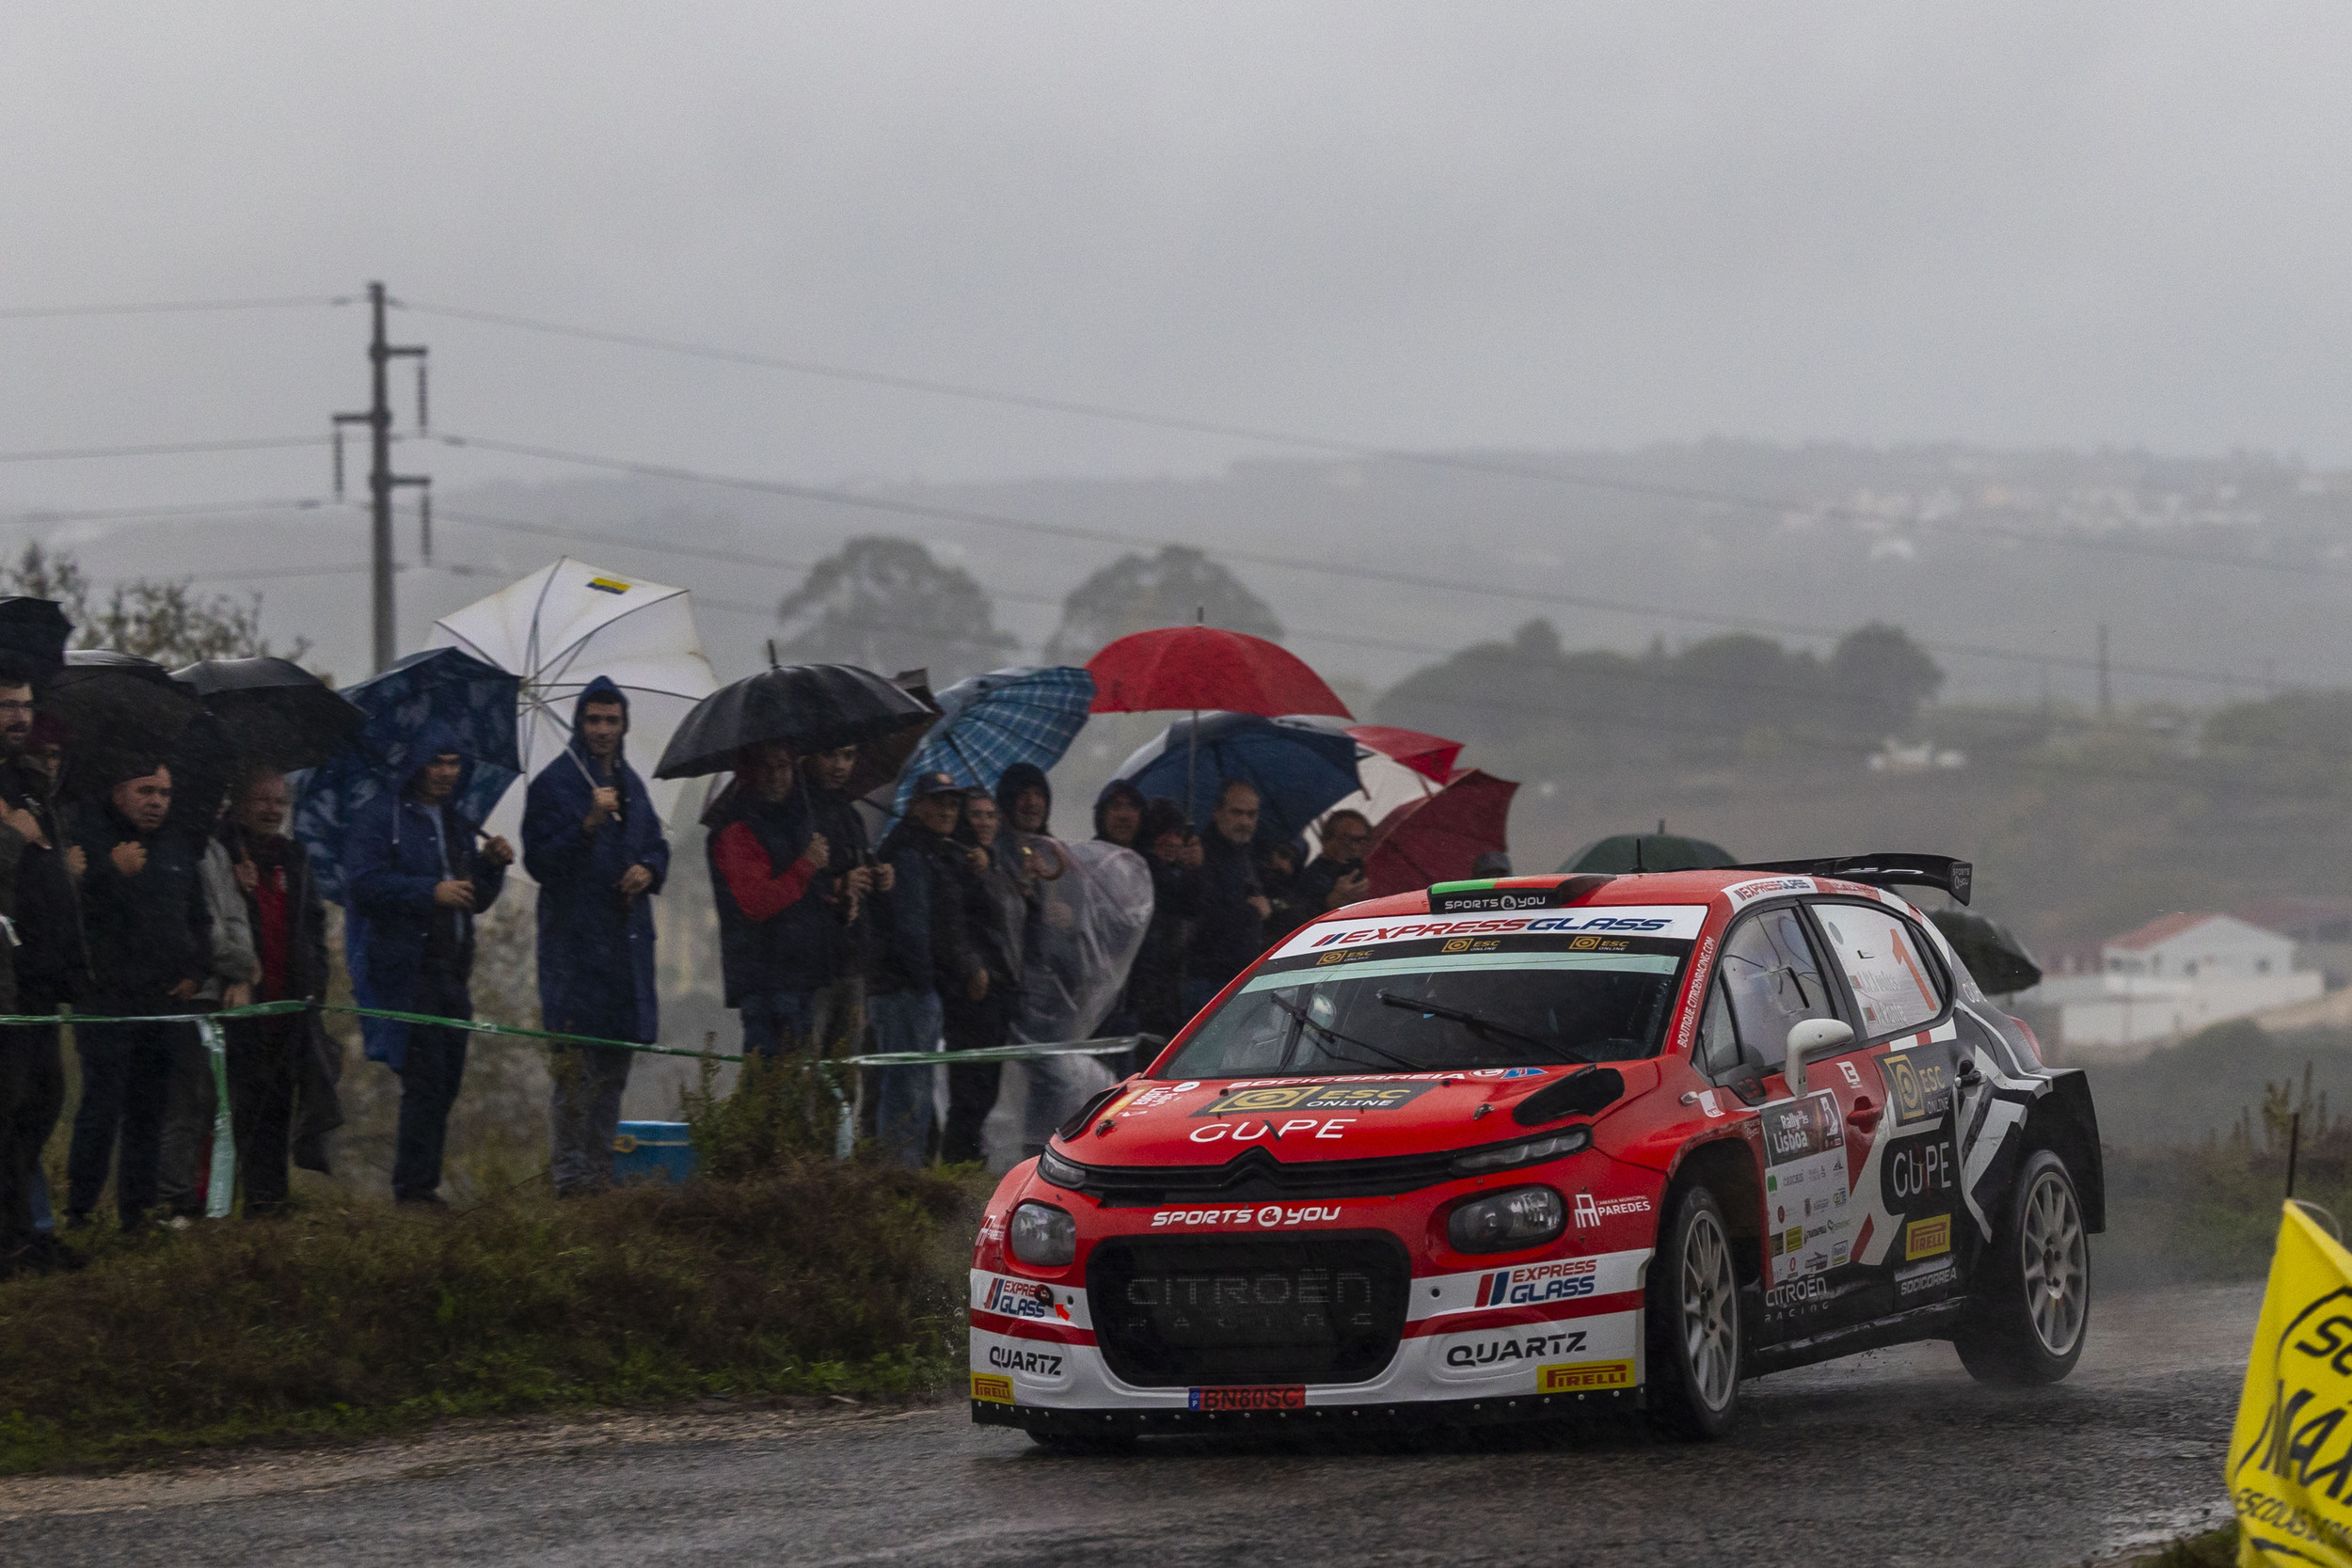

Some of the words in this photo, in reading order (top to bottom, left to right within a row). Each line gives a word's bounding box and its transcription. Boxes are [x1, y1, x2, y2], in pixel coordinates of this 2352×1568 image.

[1444, 898, 1499, 910] SPORTS
[1518, 895, 1546, 908] YOU
[1338, 917, 1673, 944] EXPRESSGLASS
[1346, 949, 1375, 958] ESC
[1472, 940, 1502, 948] ESC
[1889, 928, 1938, 1011] 1
[1918, 1066, 1947, 1094] ESC
[1317, 1089, 1411, 1100] ESC
[1780, 1113, 1800, 1130] Rally
[1773, 1130, 1808, 1153] Lisboa
[1151, 1210, 1255, 1227] SPORTS
[1283, 1206, 1342, 1225] YOU
[1597, 1200, 1651, 1216] PAREDES
[1910, 1222, 1947, 1253] PIRELLI
[1511, 1259, 1597, 1284] EXPRESS
[1509, 1275, 1596, 1305] GLASS
[999, 1298, 1045, 1318] GLASS
[989, 1346, 1063, 1375] QUARTZ
[1446, 1331, 1587, 1367] QUARTZ
[1547, 1364, 1628, 1388] PIRELLI
[975, 1377, 1010, 1399] PIRELLI
